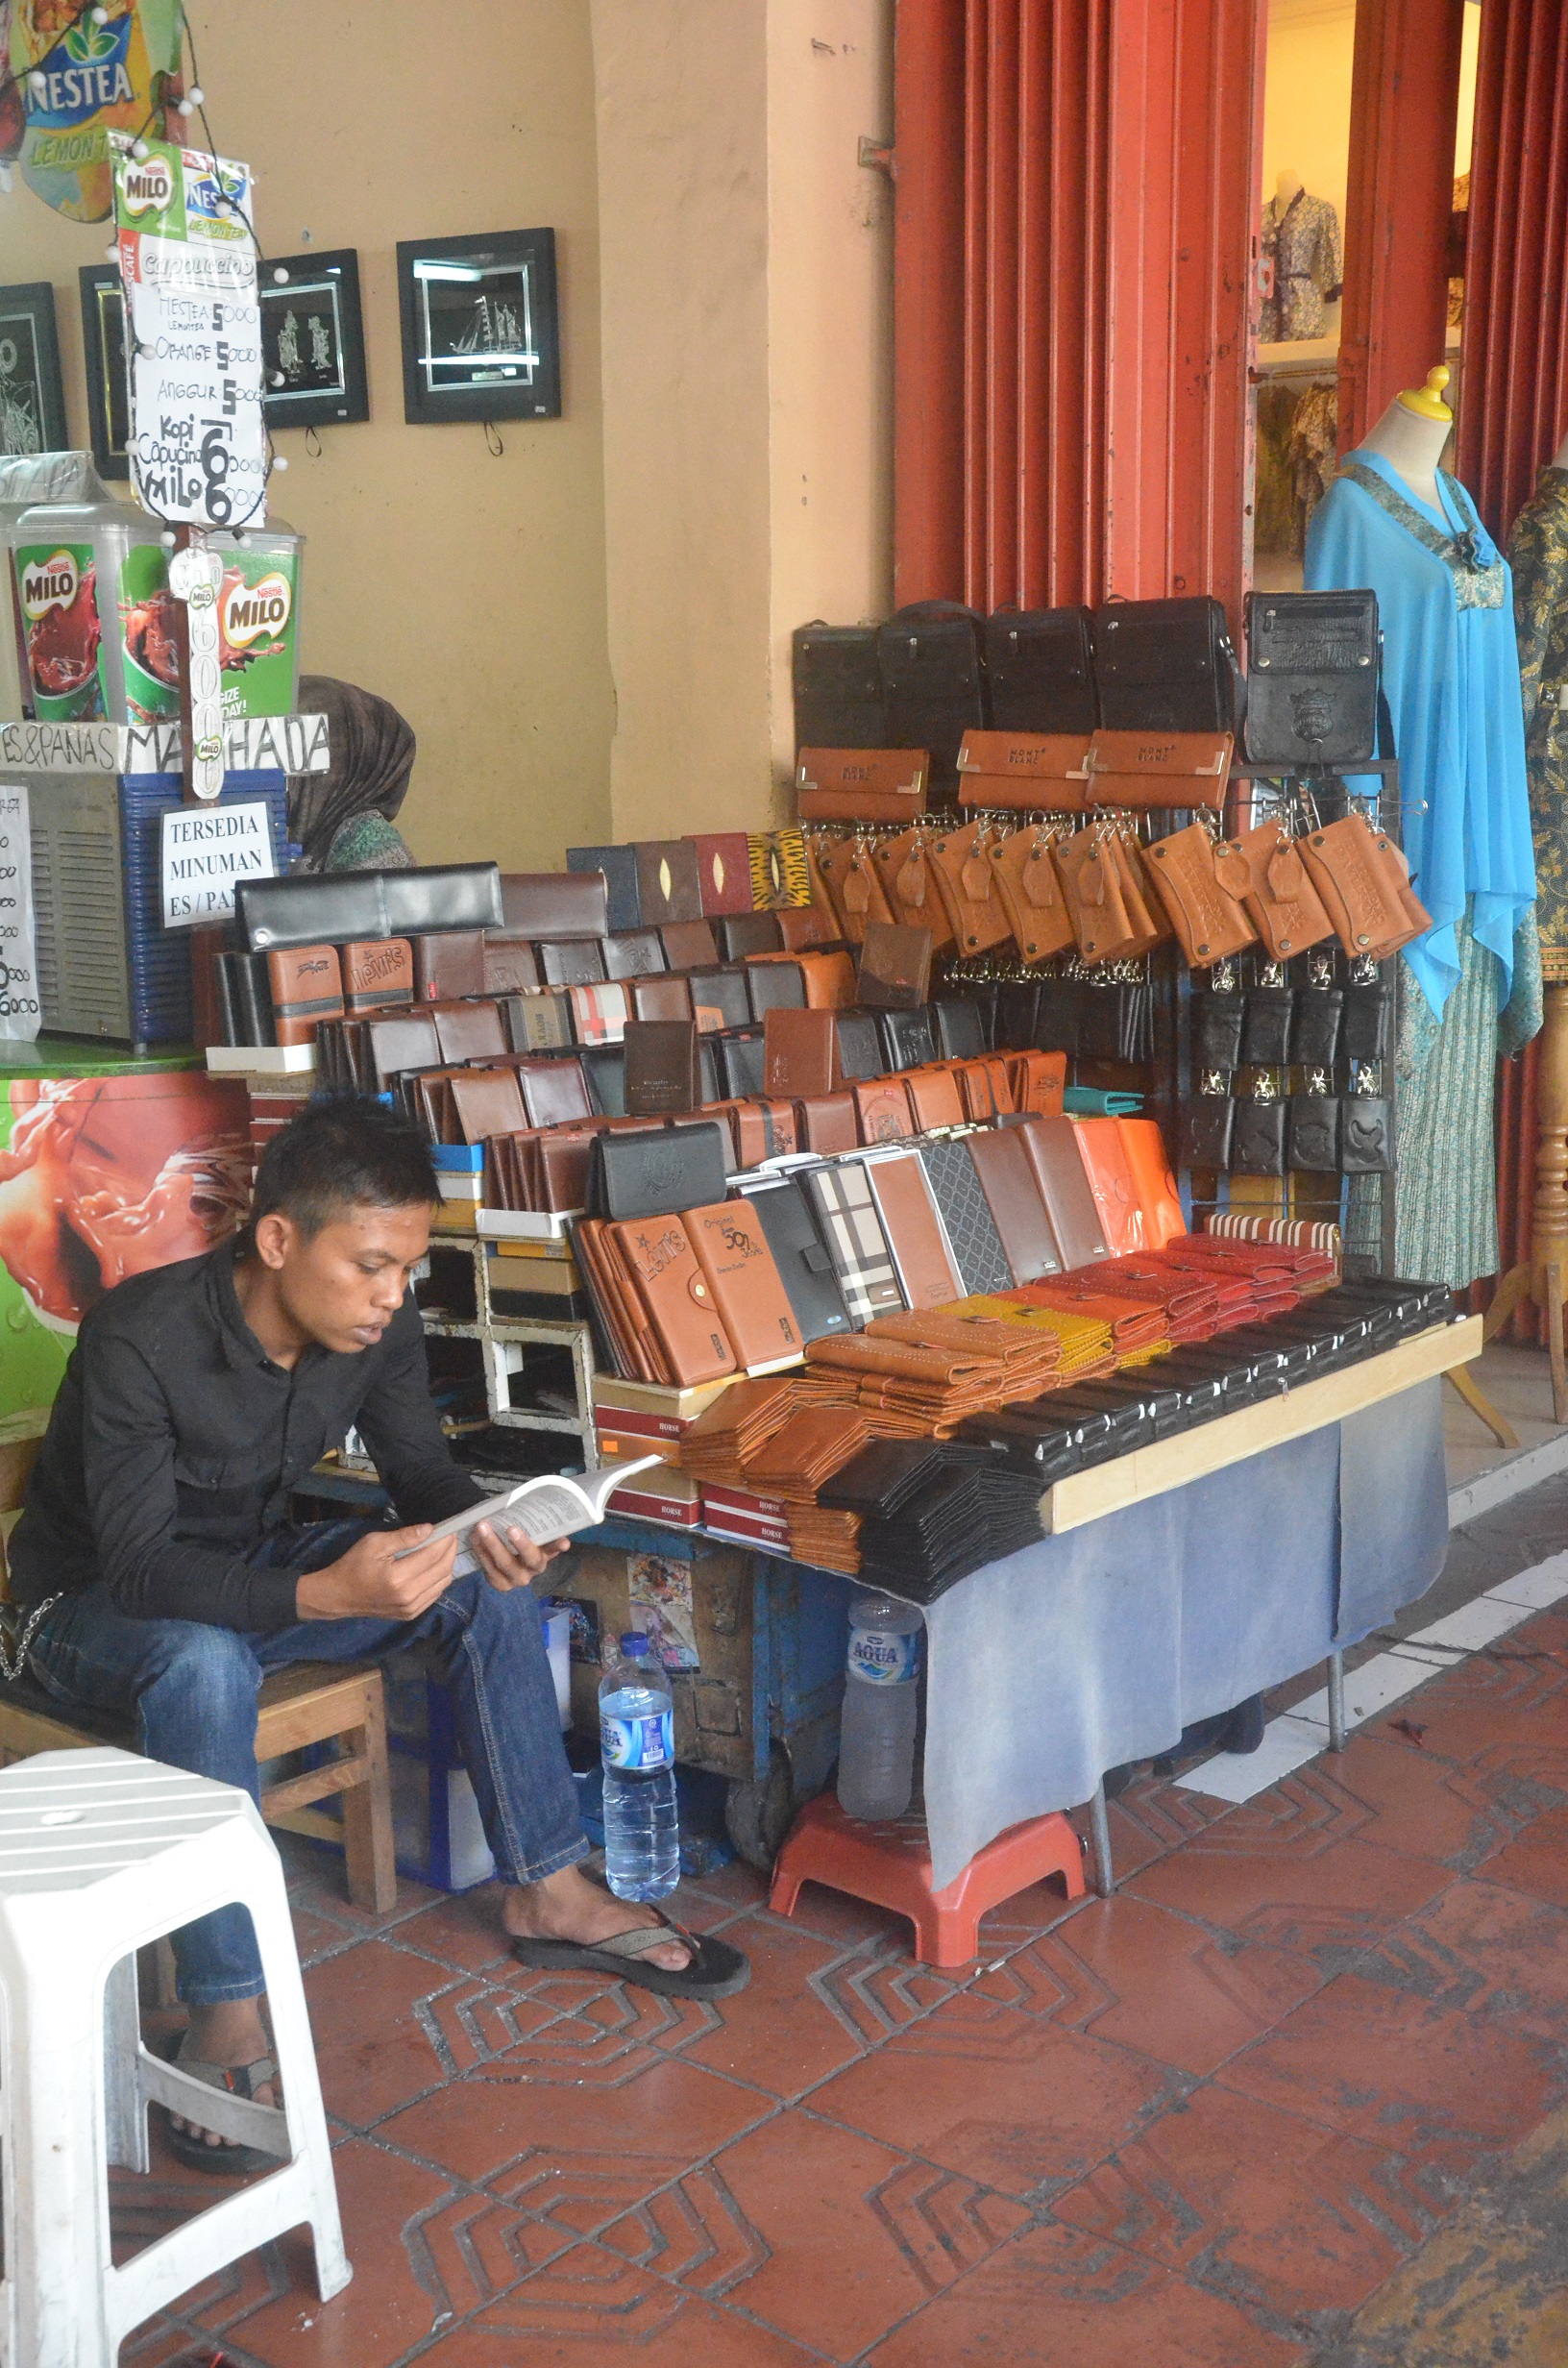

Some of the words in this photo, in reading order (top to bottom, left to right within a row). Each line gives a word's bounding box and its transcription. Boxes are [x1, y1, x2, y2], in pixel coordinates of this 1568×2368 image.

[27, 62, 134, 112] NESTEA
[126, 175, 168, 198] MILO
[159, 413, 194, 447] Kopi
[25, 573, 74, 604] MILO
[193, 592, 211, 602] MILO
[230, 597, 284, 629] MILO
[200, 745, 219, 754] MILO
[171, 815, 259, 843] TERSEDIA
[170, 850, 262, 880] MINUMAN
[170, 895, 191, 917] ES
[659, 1422, 680, 1433] HORSE
[661, 1505, 682, 1517] HORSE
[759, 1501, 781, 1513] HORSE
[761, 1527, 783, 1539] HORSE
[853, 1641, 899, 1664] AQUA
